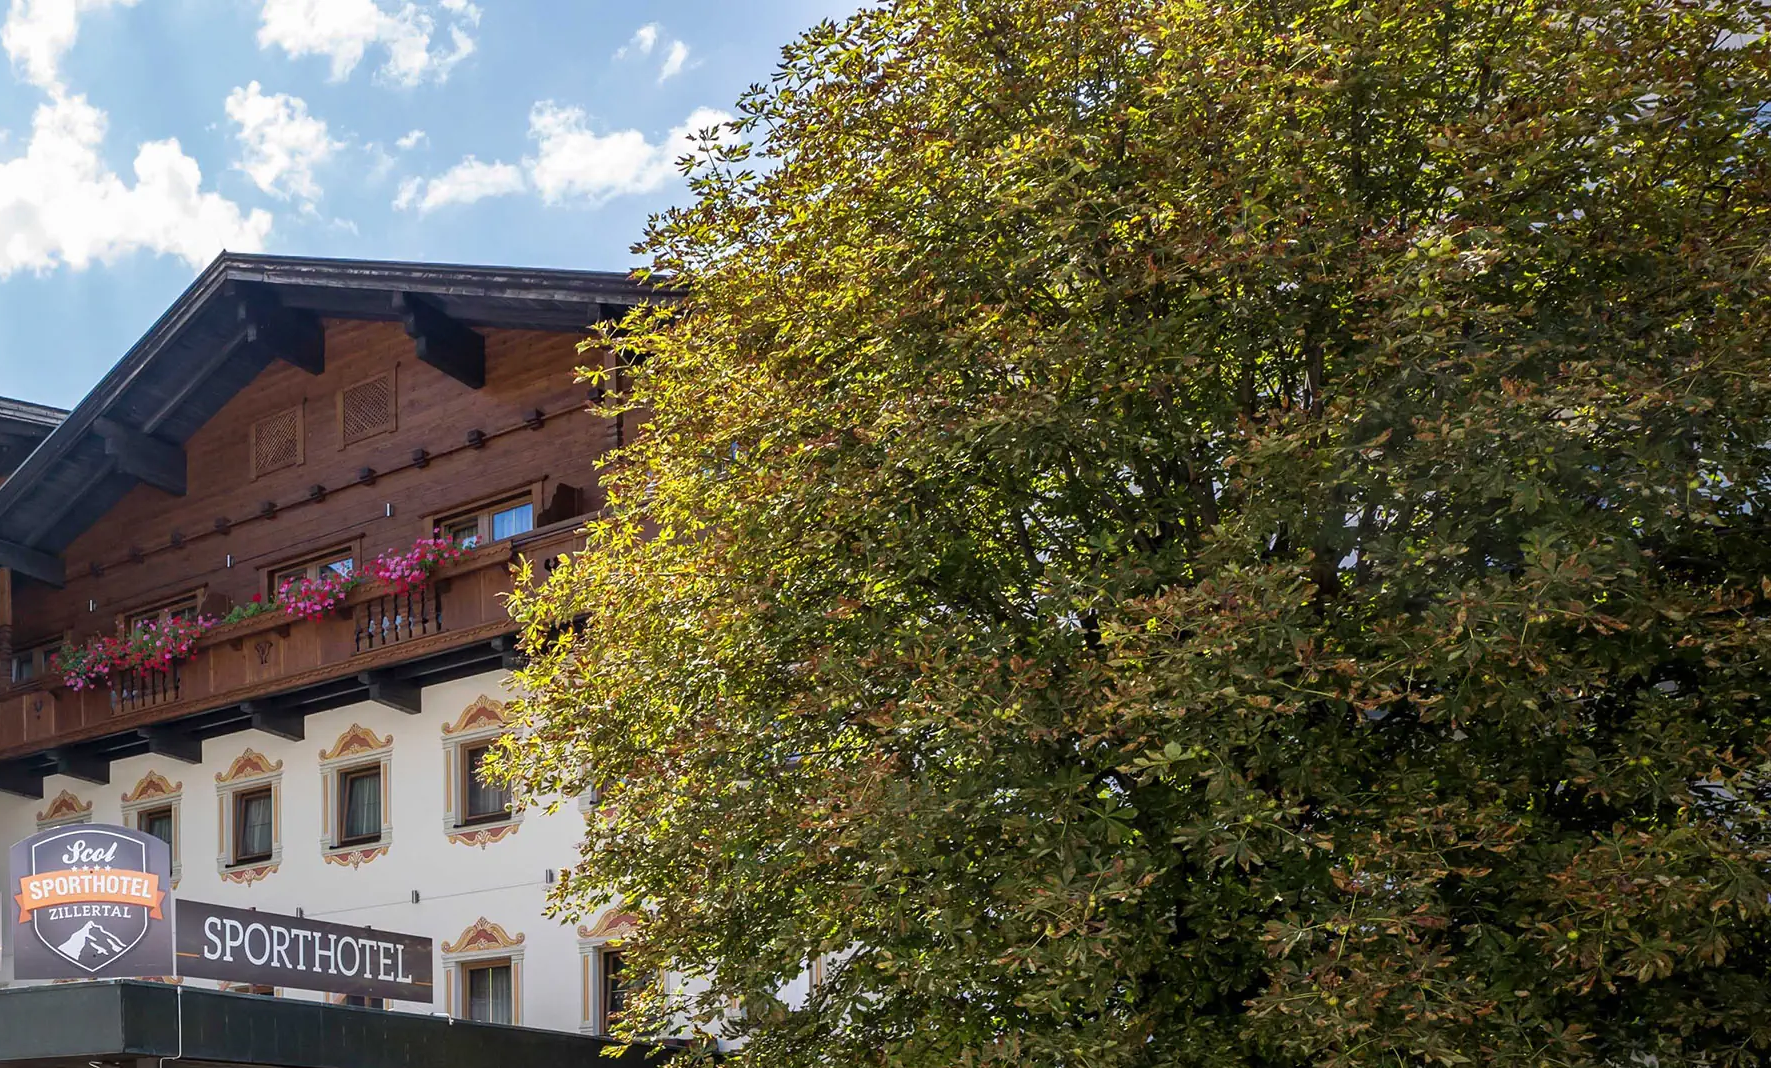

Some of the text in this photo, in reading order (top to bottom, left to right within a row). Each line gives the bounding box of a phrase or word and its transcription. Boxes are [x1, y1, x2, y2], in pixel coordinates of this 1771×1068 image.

[62, 840, 118, 864] Scol
[29, 875, 152, 900] SPORTHOTEL
[49, 905, 132, 921] ZILLERTAL
[203, 916, 413, 984] SPORTHOTEL
